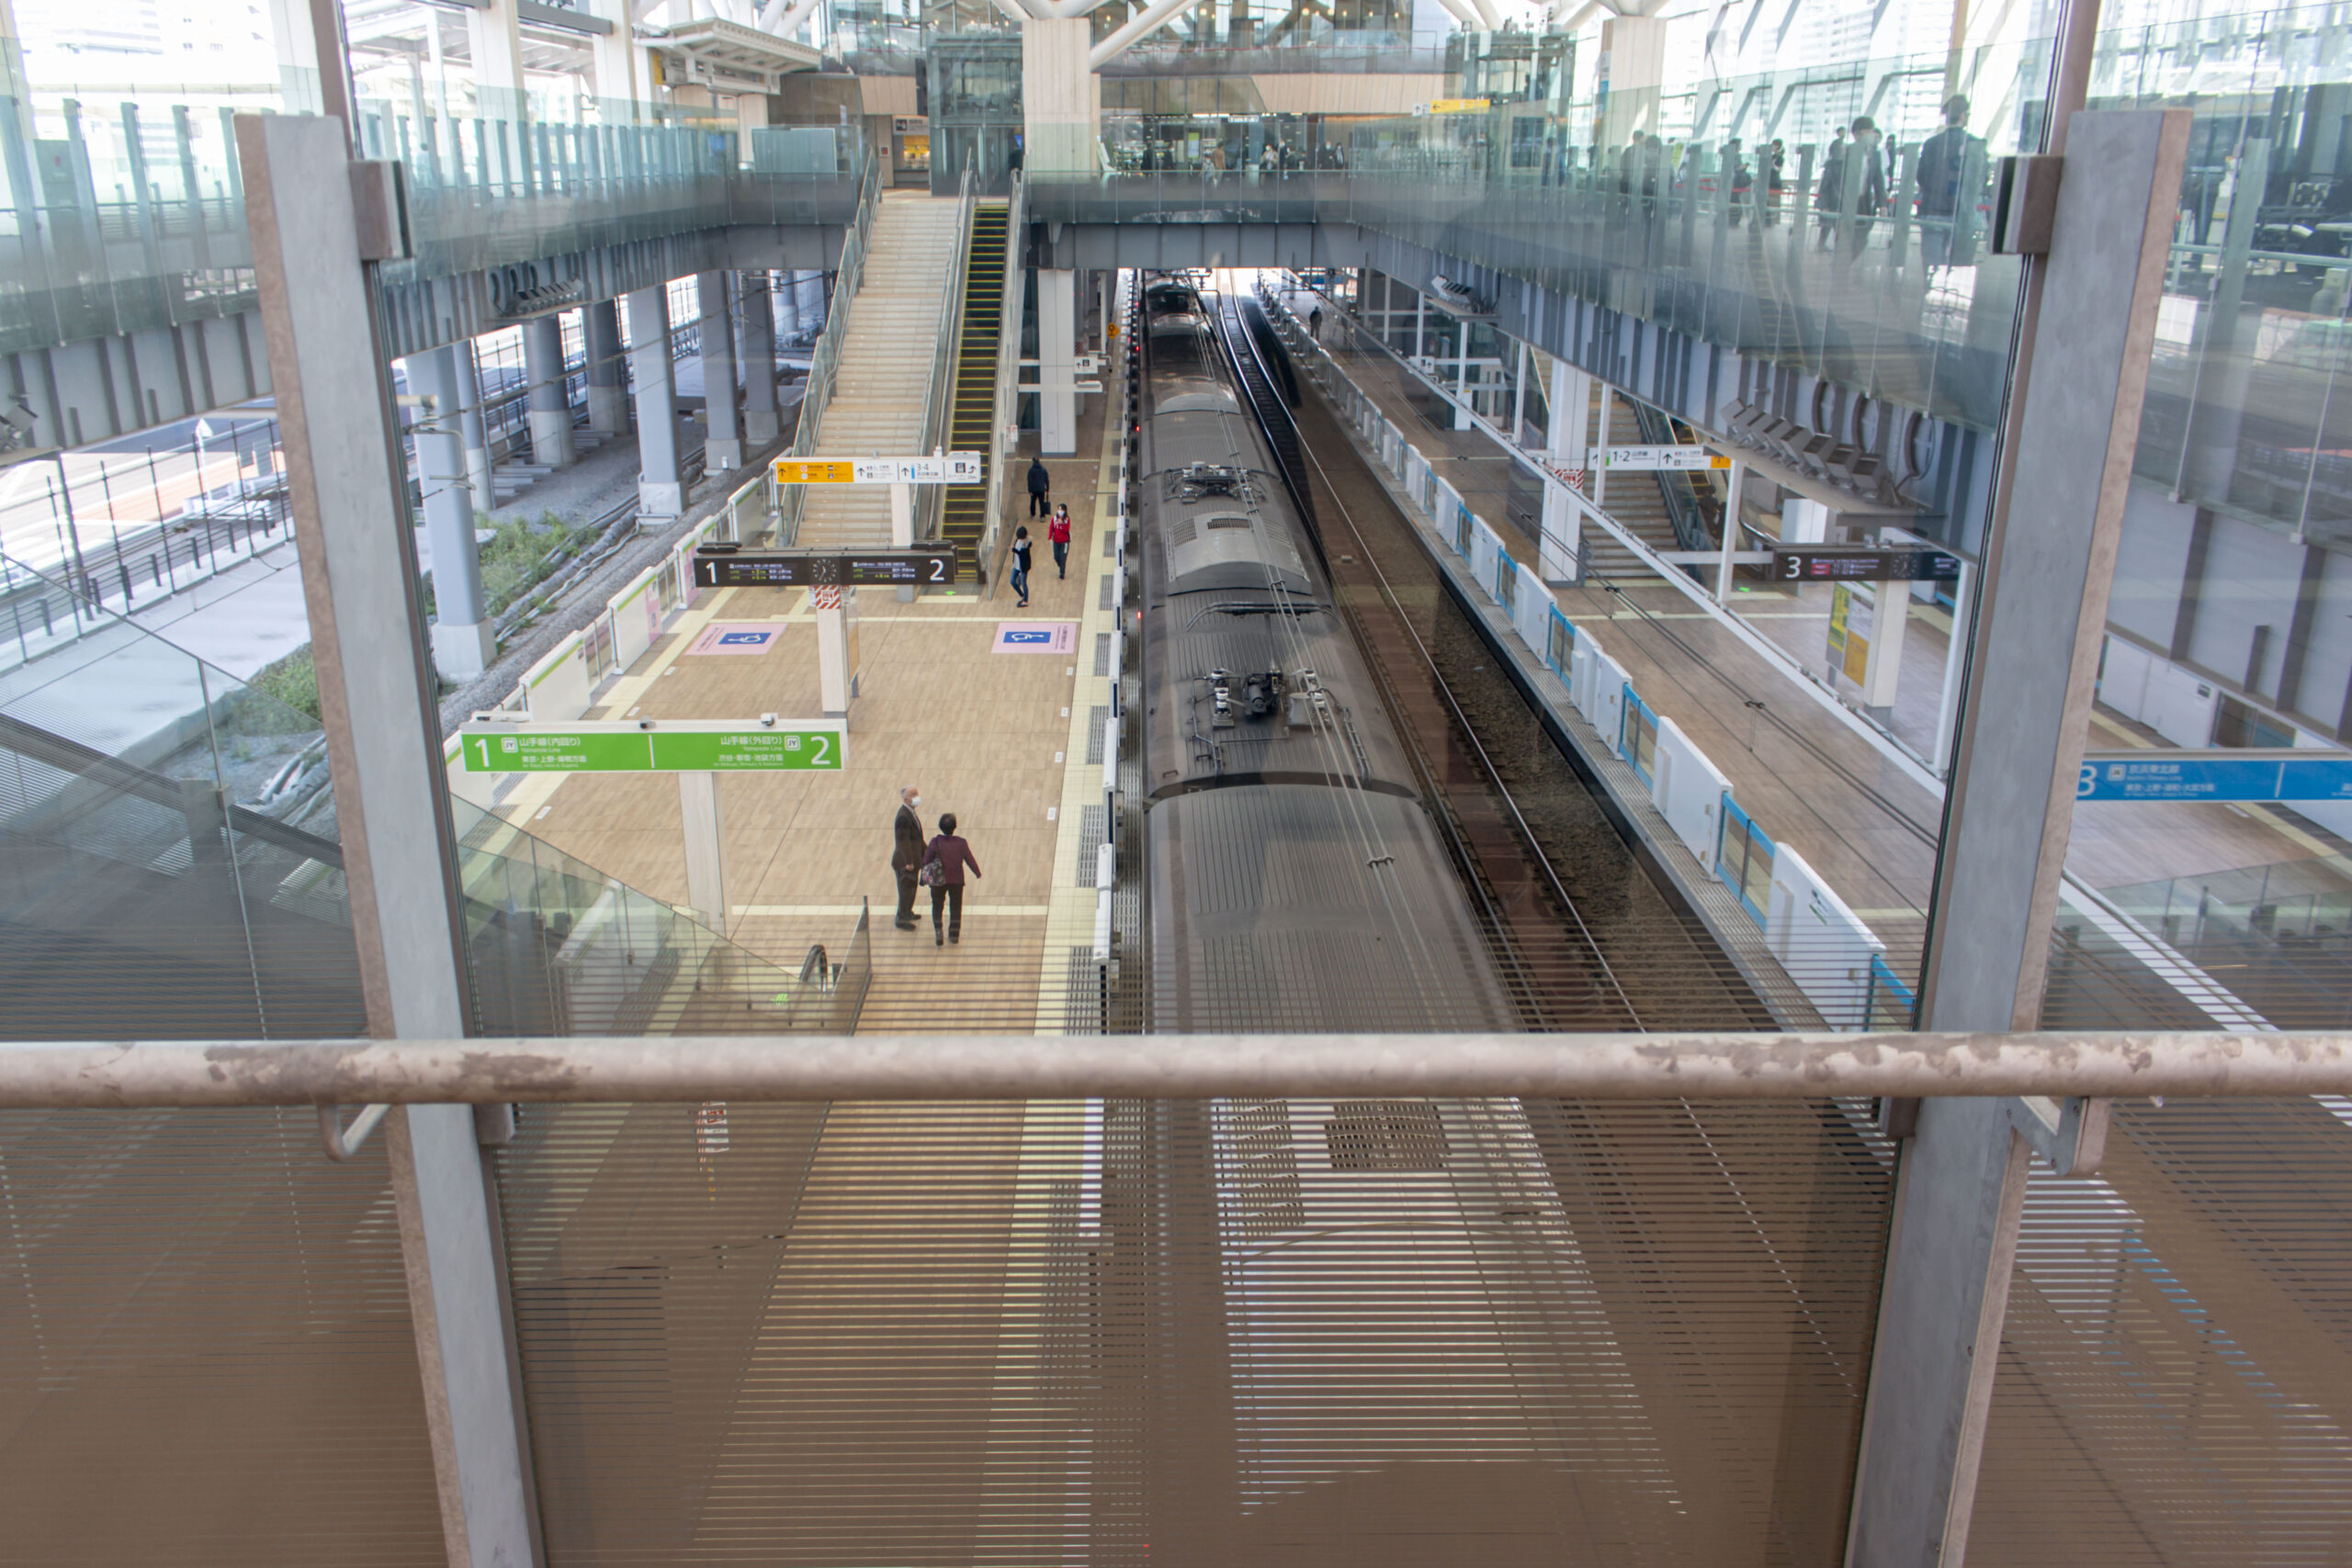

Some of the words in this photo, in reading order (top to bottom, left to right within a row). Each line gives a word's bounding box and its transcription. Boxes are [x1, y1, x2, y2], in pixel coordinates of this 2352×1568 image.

[705, 561, 717, 584] 1
[929, 558, 945, 581] 2
[1785, 556, 1802, 579] 3
[474, 738, 490, 768] 1
[810, 736, 831, 765] 2
[2076, 764, 2098, 797] 3
